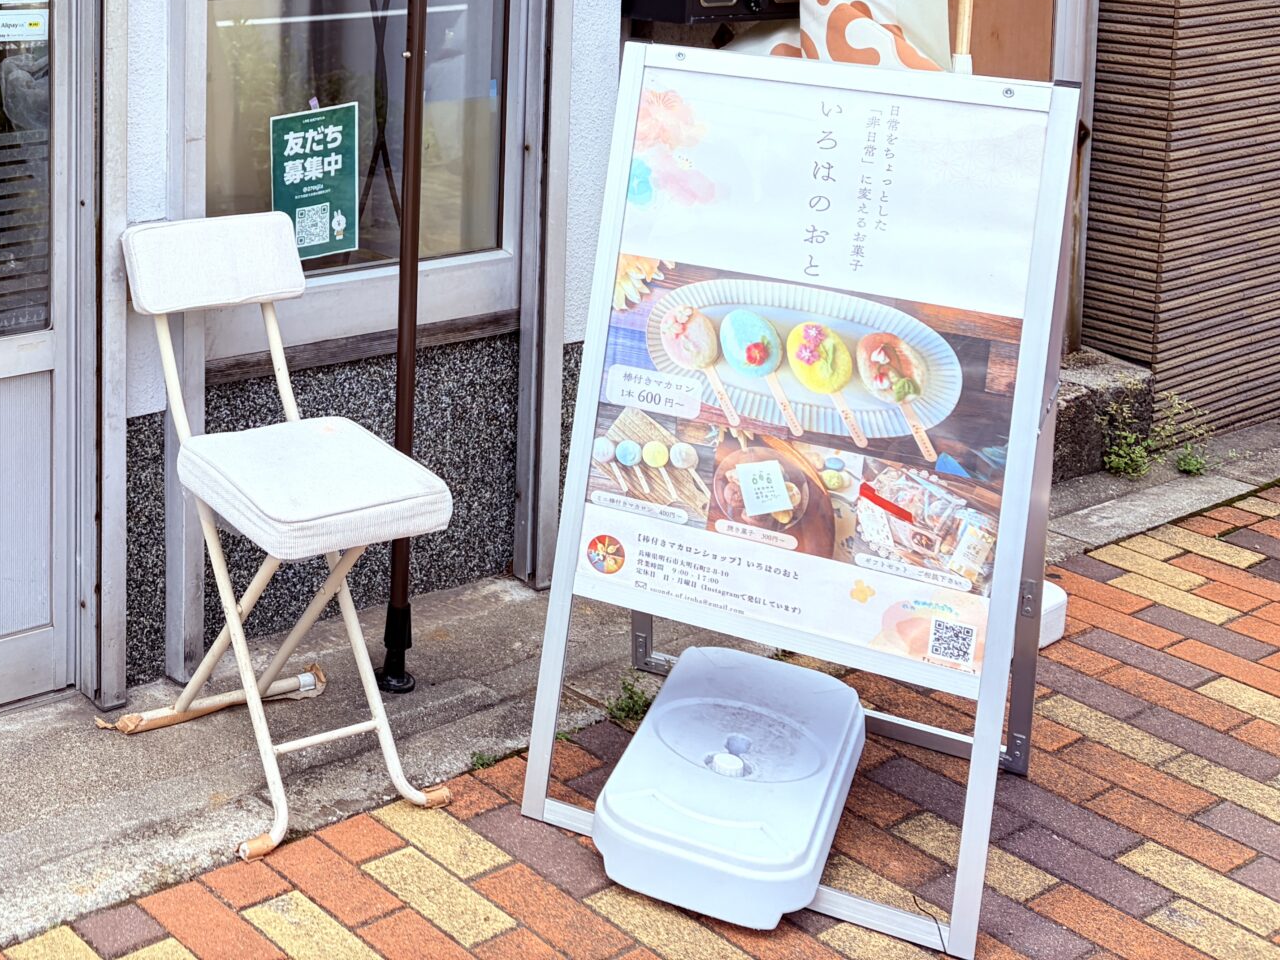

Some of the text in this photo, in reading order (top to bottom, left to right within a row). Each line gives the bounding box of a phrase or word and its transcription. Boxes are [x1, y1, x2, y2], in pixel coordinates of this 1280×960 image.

[283, 125, 343, 157] 友だち
[283, 152, 342, 185] 募集中
[874, 105, 901, 232] 日常をちょっとした
[803, 101, 843, 277] いろはのおと
[849, 108, 883, 272] 「非日常」に変えるお菓子
[623, 372, 695, 392] 棒付きマカロン
[637, 389, 662, 406] 600
